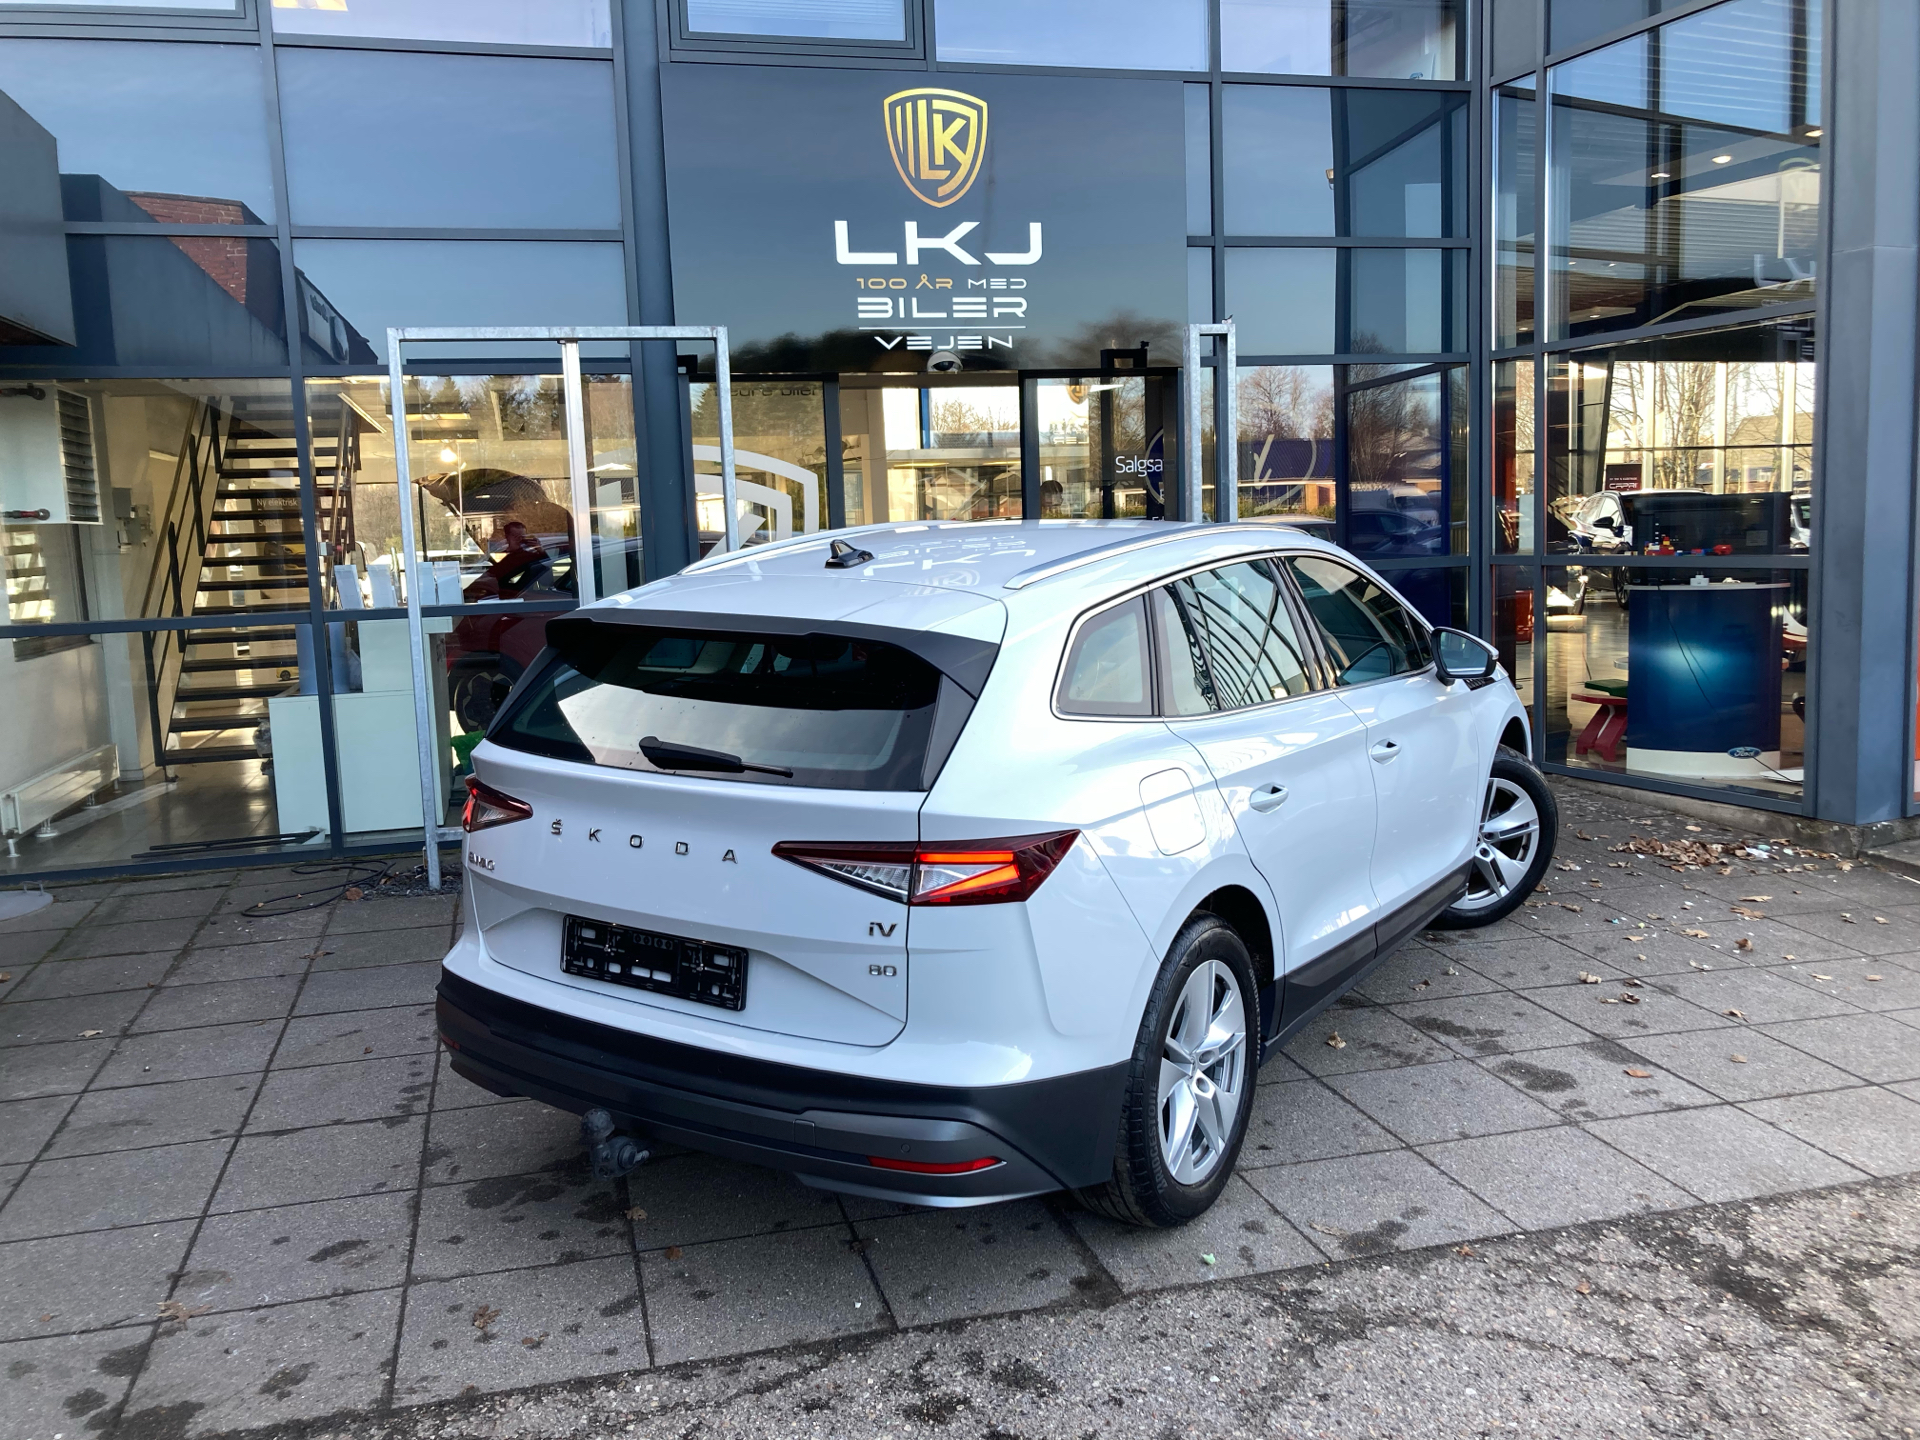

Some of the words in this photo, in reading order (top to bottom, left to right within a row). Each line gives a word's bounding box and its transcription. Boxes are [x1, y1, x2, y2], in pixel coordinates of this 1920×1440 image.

[834, 220, 1042, 265] LKJ
[857, 278, 907, 290] 100
[915, 273, 953, 290] ÅR
[968, 278, 1027, 290] MED
[857, 297, 1028, 318] BILER
[874, 335, 1013, 351] VEJEN
[551, 819, 738, 864] ŠKODA
[869, 965, 897, 977] 80
